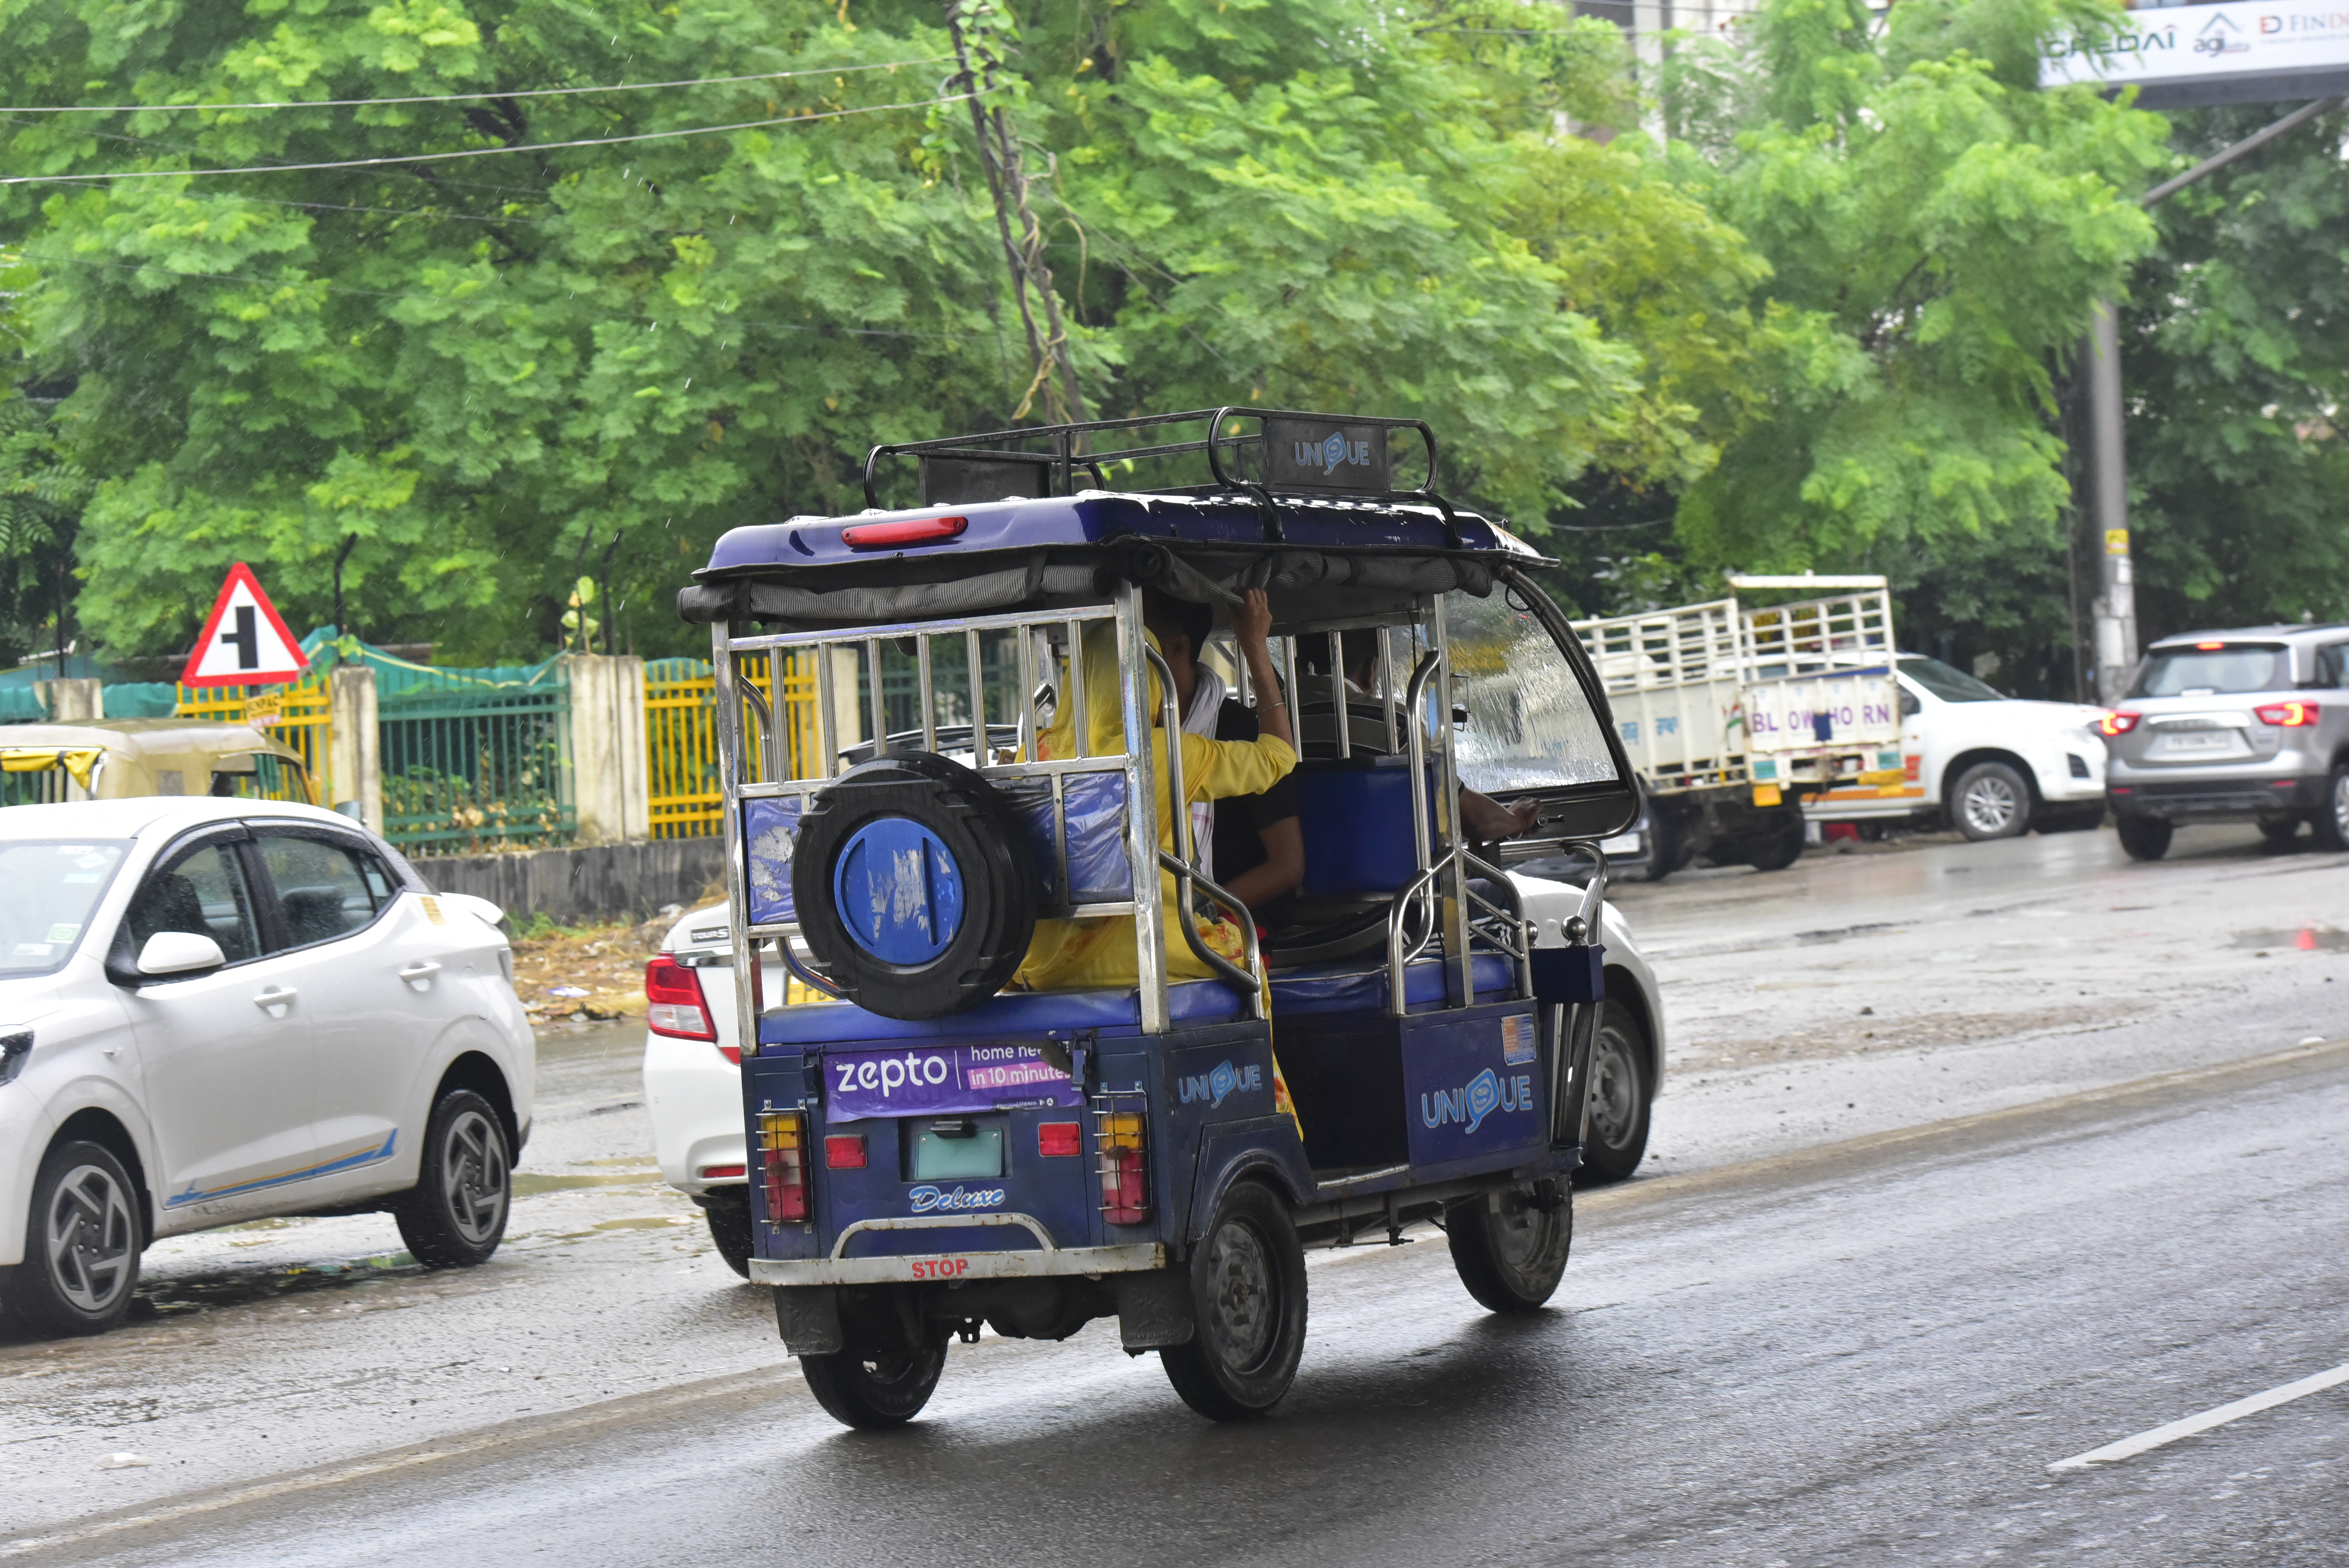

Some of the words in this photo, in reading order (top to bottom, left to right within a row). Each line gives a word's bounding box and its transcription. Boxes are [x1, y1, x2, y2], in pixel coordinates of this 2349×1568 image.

[1295, 431, 1369, 475] UNIQUE
[971, 1046, 1014, 1061] home
[836, 1051, 947, 1098] zepto
[971, 1069, 986, 1085] in
[988, 1067, 1006, 1084] 10
[1178, 1059, 1262, 1109] UNIQUE
[1421, 1067, 1533, 1134] UNIQUE
[909, 1185, 1006, 1213] Deluxe
[912, 1258, 968, 1278] STOP
